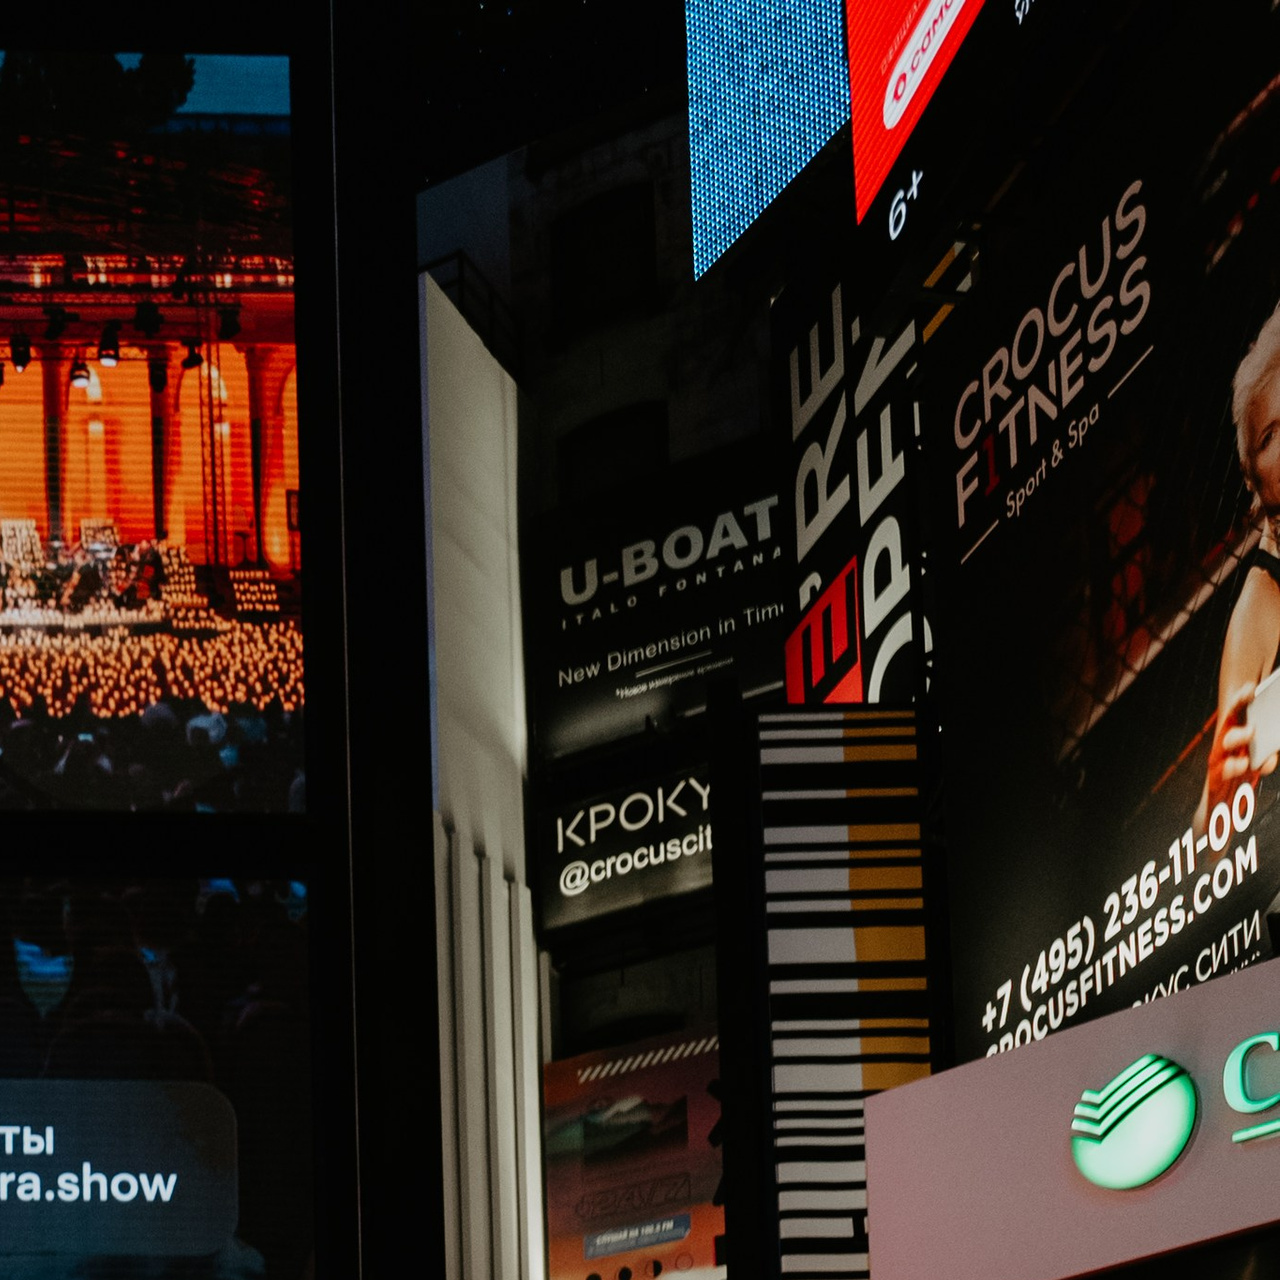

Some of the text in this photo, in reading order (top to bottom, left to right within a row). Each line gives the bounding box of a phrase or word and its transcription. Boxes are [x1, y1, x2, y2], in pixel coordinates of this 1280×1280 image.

[888, 169, 924, 241] 6+
[953, 179, 1147, 450] CROCUS
[1005, 402, 1100, 518] Sport & Spa
[559, 494, 779, 607] U-BOAT
[561, 545, 782, 631] ITALO FONTANA
[557, 661, 602, 688] New
[606, 625, 711, 673] Dimension
[718, 617, 736, 636] in
[559, 823, 713, 897] @crocuscit
[982, 782, 1256, 1034] +7 (495) 236-11-00
[1195, 909, 1261, 983] СИТИ
